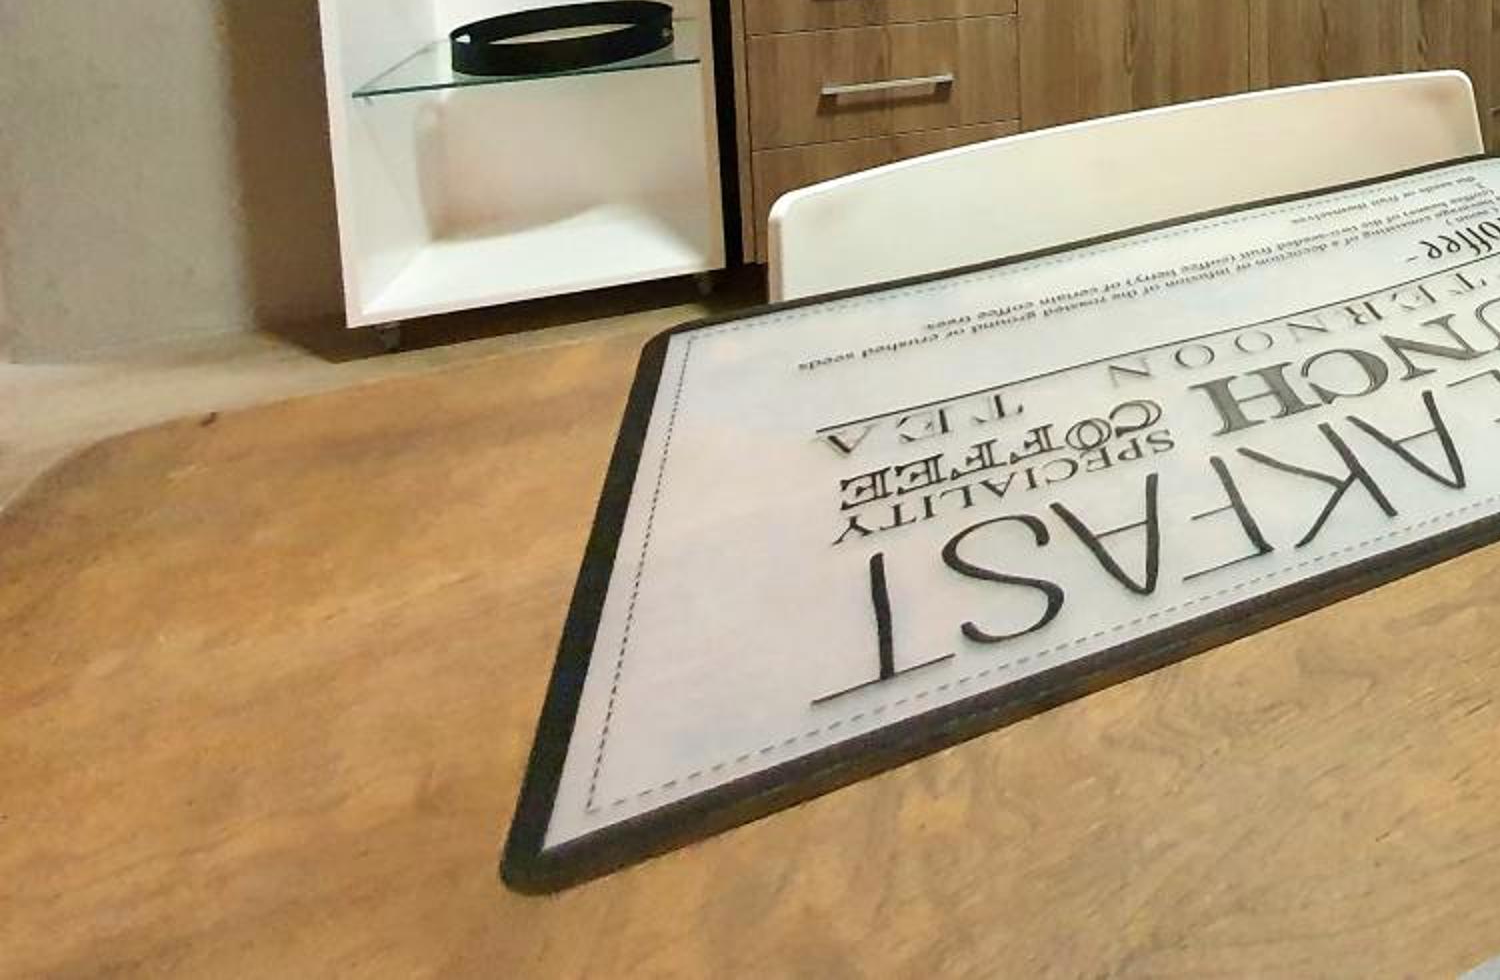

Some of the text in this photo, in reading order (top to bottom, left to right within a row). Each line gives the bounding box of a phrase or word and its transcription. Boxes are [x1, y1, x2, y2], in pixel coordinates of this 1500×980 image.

[824, 394, 1024, 455] TEA
[840, 399, 1163, 511] COFFEE
[832, 428, 1175, 546] SPECIALITY
